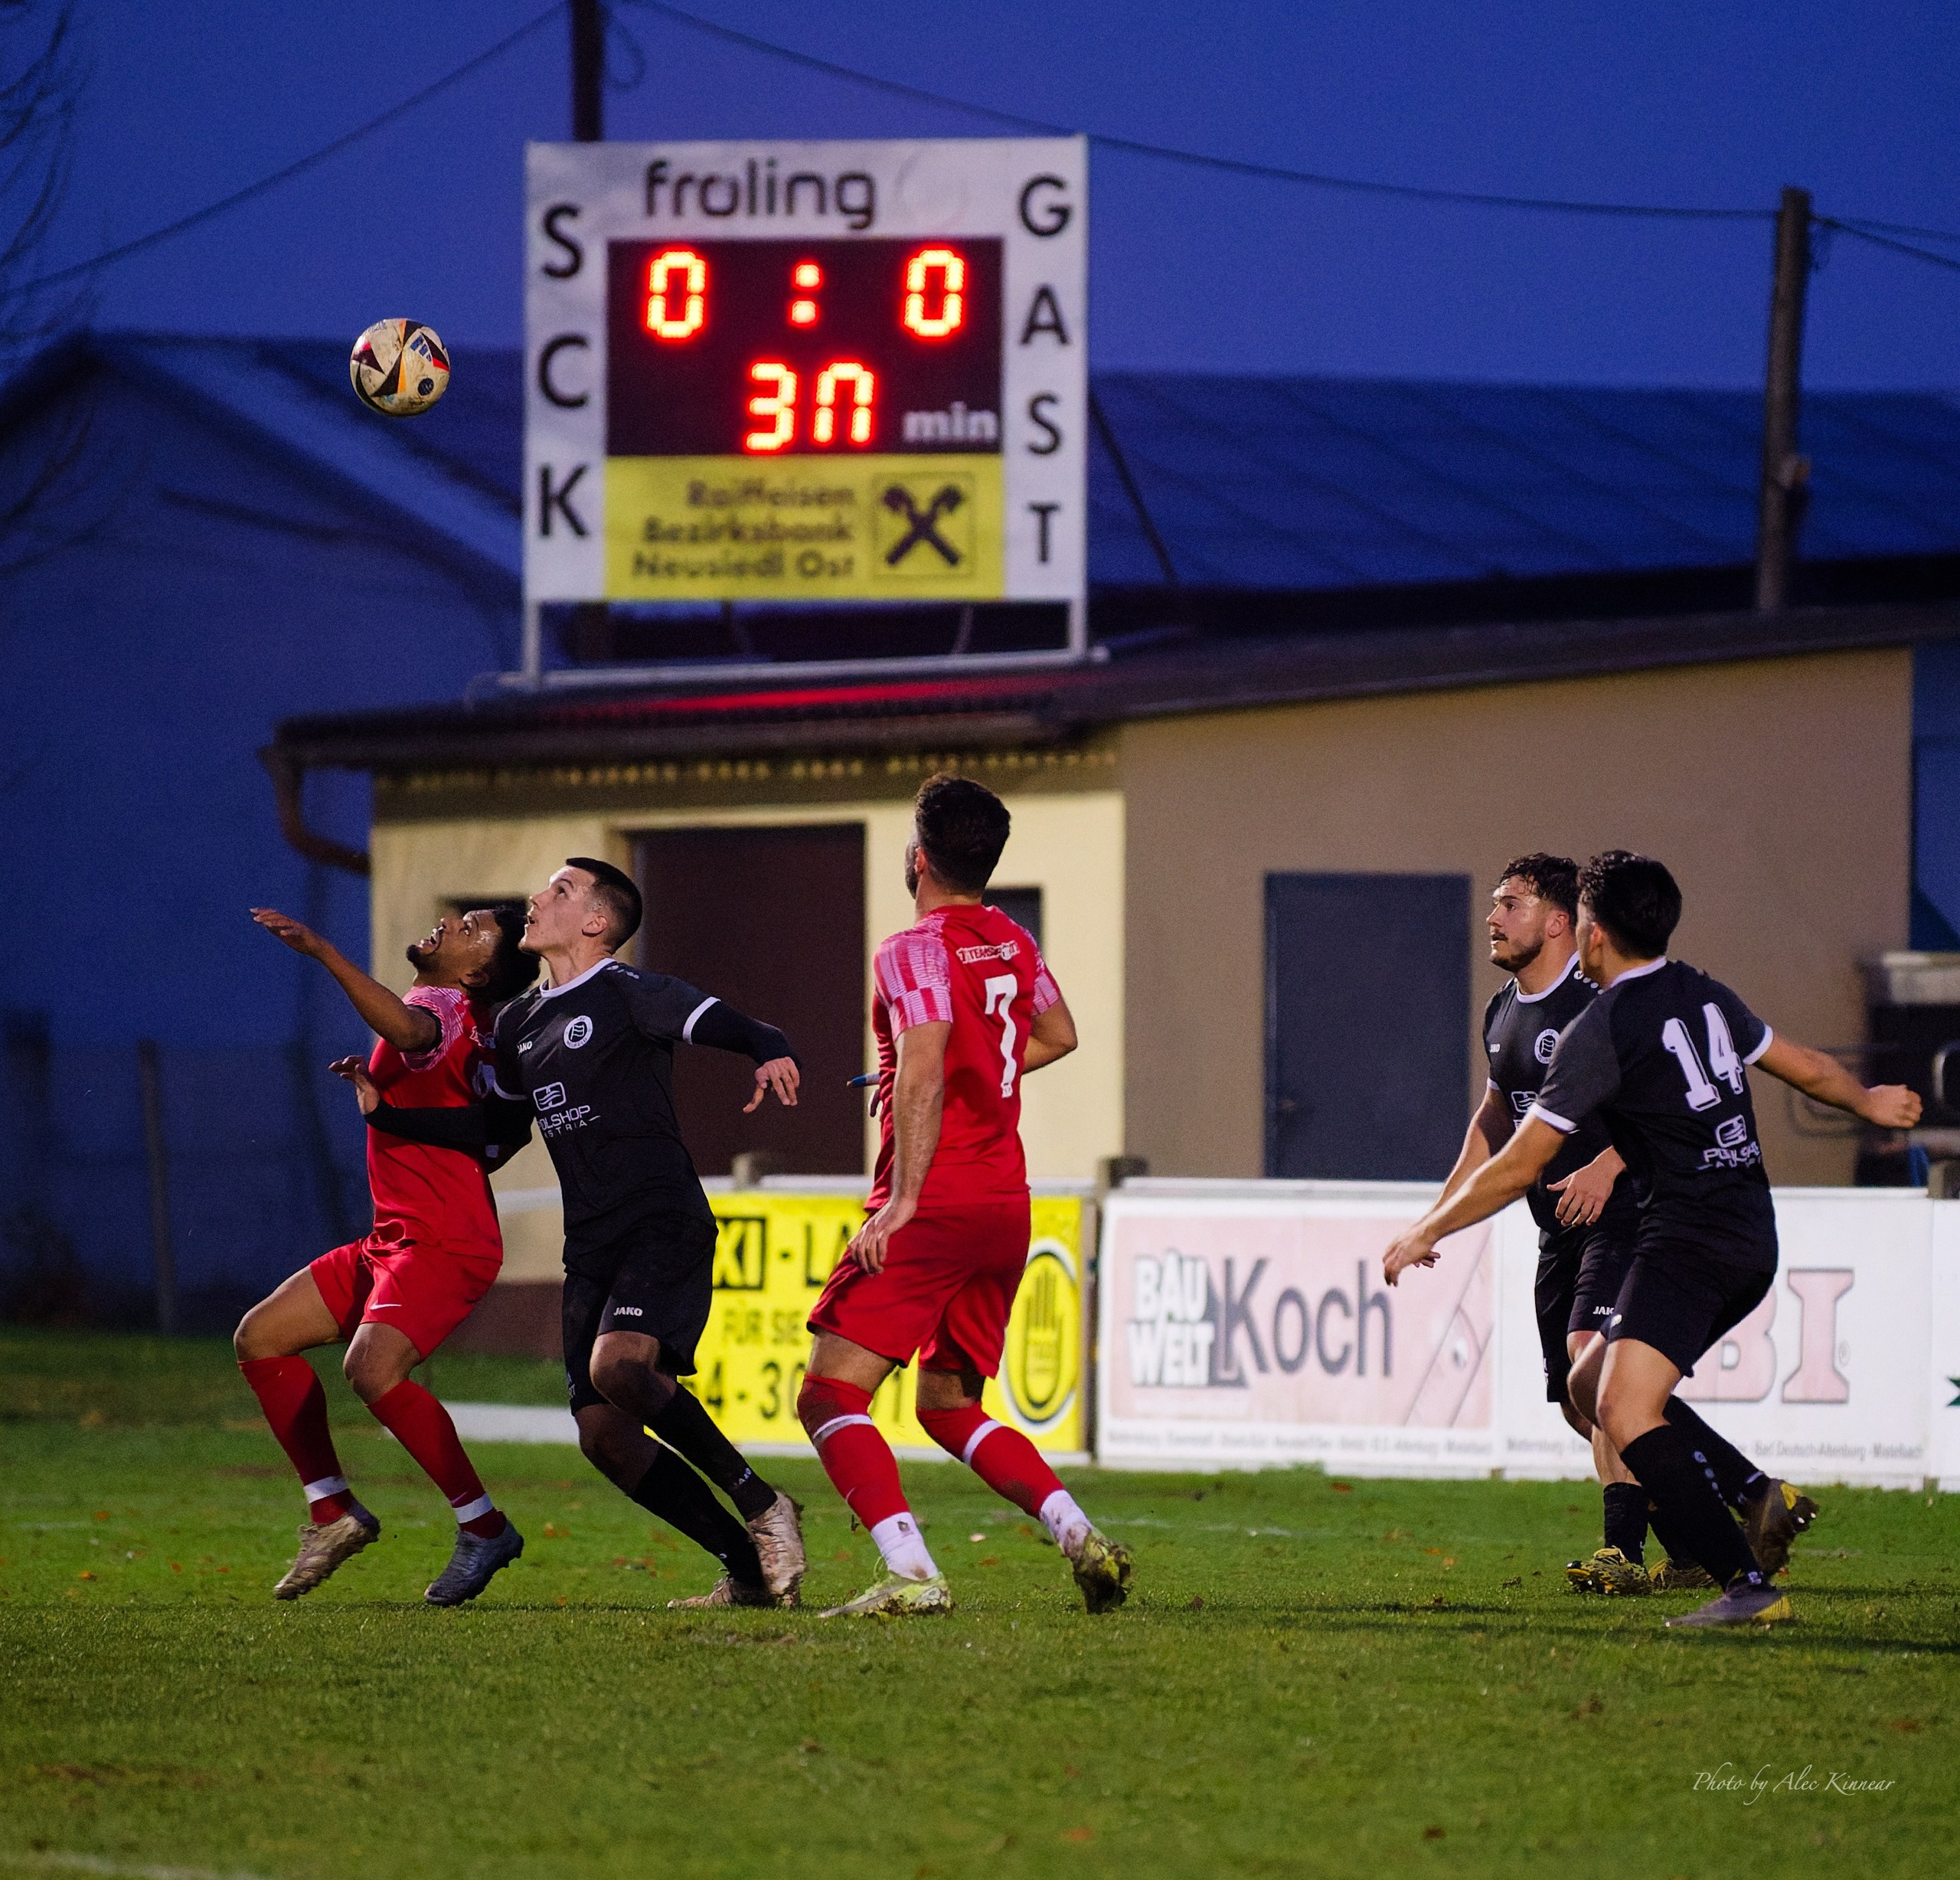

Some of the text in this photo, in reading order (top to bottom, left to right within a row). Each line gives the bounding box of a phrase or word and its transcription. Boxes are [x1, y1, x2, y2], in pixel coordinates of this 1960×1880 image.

[646, 250, 707, 338] 0
[904, 248, 966, 337] 0
[903, 403, 997, 441] min
[688, 478, 854, 507] Raiffeisen
[795, 548, 854, 579] Ost
[985, 973, 1018, 1097] 7
[1663, 1002, 1745, 1111] 14
[612, 1306, 643, 1316] JAKO
[1135, 1248, 1394, 1377] BAU Koch
[1126, 1322, 1215, 1385] WELT
